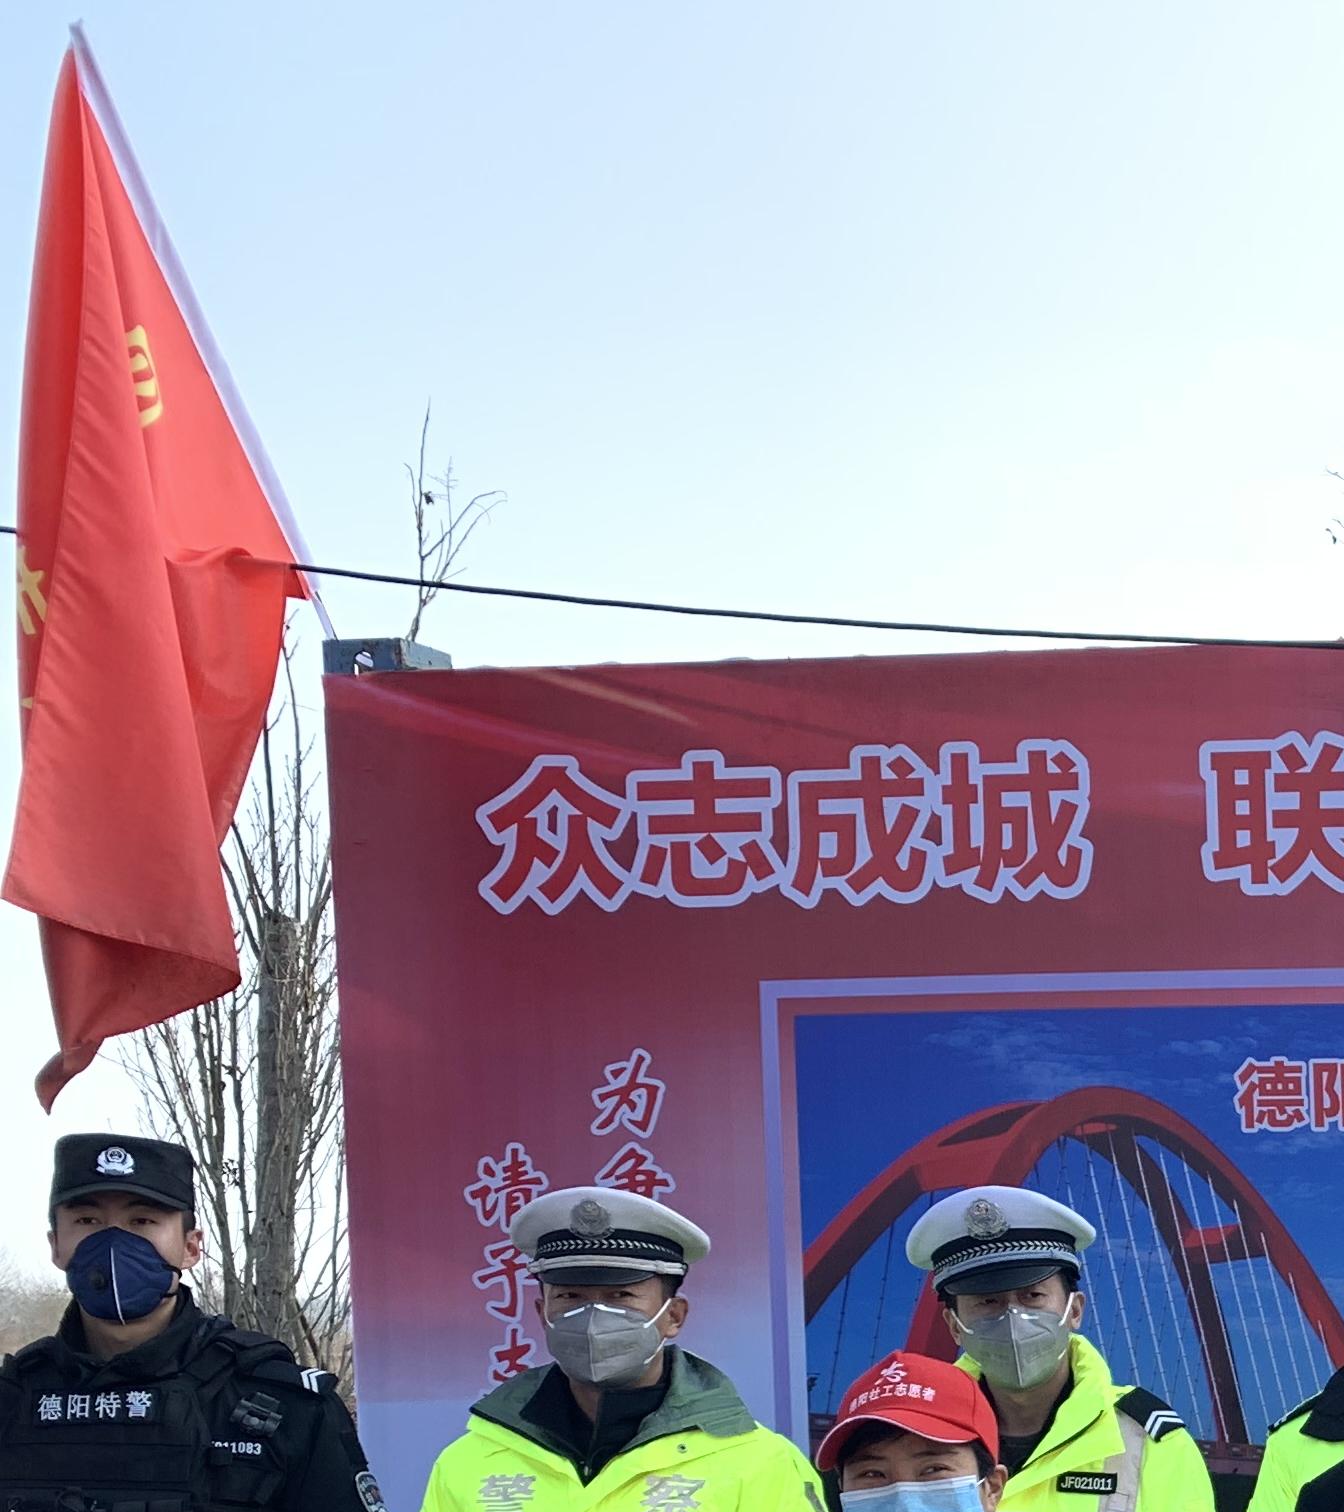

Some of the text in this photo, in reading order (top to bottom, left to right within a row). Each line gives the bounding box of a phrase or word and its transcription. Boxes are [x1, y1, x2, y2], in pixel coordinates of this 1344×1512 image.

[479, 738, 1094, 915] 众志成城
[38, 1390, 152, 1421] 德阳特警
[1061, 1476, 1112, 1490] JF021011
